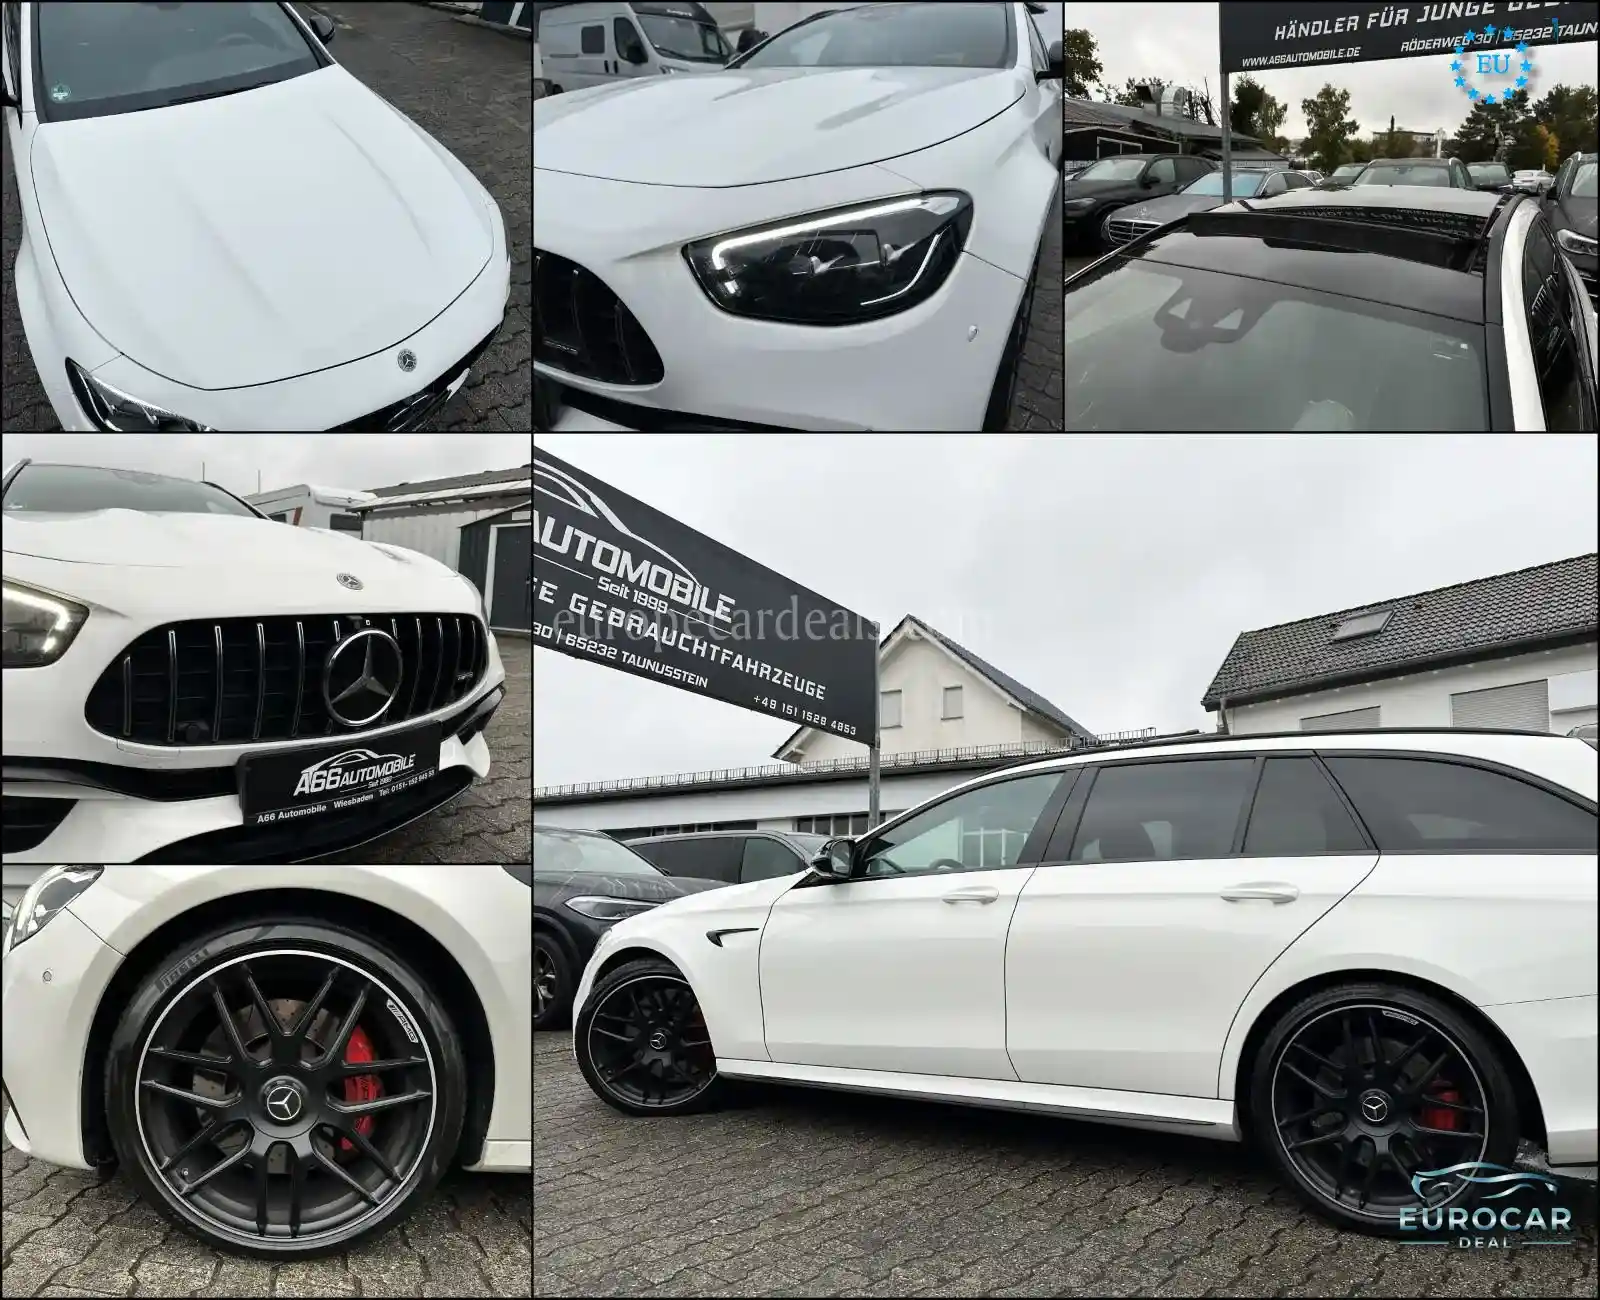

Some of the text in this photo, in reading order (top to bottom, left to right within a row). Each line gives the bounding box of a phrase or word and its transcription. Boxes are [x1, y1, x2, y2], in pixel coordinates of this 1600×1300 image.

[1275, 15, 1360, 41] HÄNDLER
[1367, 6, 1409, 29] FÜR
[1416, 2, 1494, 23] JUNGE
[1558, 22, 1598, 37] TAUN
[533, 509, 736, 624] UTOMOBILE
[597, 576, 669, 614] Seit 1999
[533, 576, 826, 701] E GEBRAUCHTFAHRZEUGE
[565, 633, 618, 660] 65232
[621, 650, 709, 688] TAUNUSSTEIN
[753, 695, 777, 709] +49
[782, 702, 798, 717] 151
[802, 710, 827, 726] 1529
[257, 812, 276, 824] A66
[278, 804, 327, 820] Automobile
[333, 793, 374, 809] Wiesbaden
